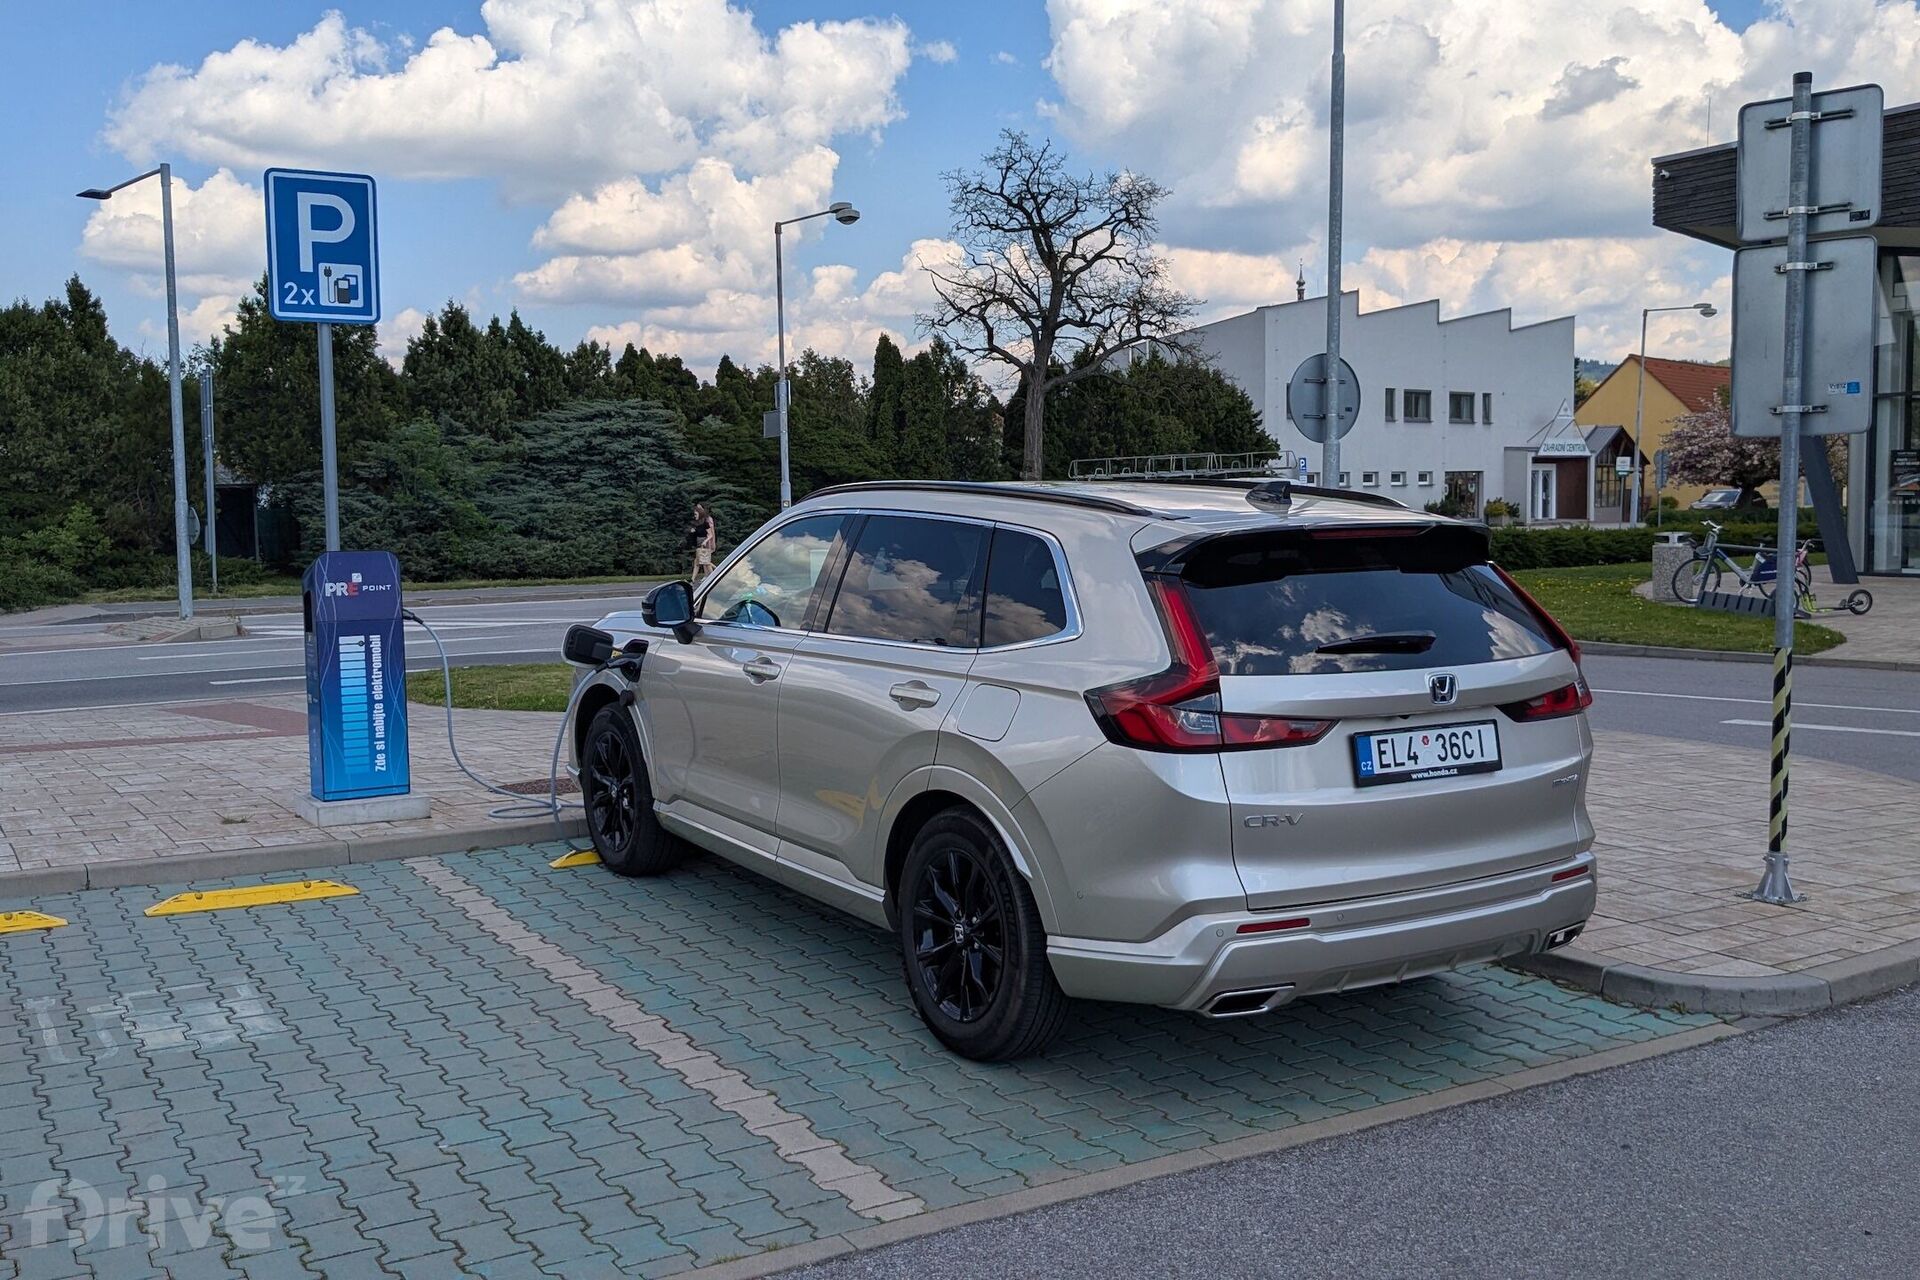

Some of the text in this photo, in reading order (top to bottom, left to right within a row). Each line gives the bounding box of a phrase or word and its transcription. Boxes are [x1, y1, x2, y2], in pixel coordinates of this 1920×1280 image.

[297, 192, 355, 272] P
[283, 281, 316, 305] 2x
[325, 582, 391, 597] PRE POINT
[369, 634, 387, 772] Zde si nabijte elektromobil
[1376, 736, 1419, 769] EL4
[1361, 760, 1373, 771] CZ
[1411, 768, 1458, 779] www.honda.cz
[1244, 812, 1304, 828] CR-V
